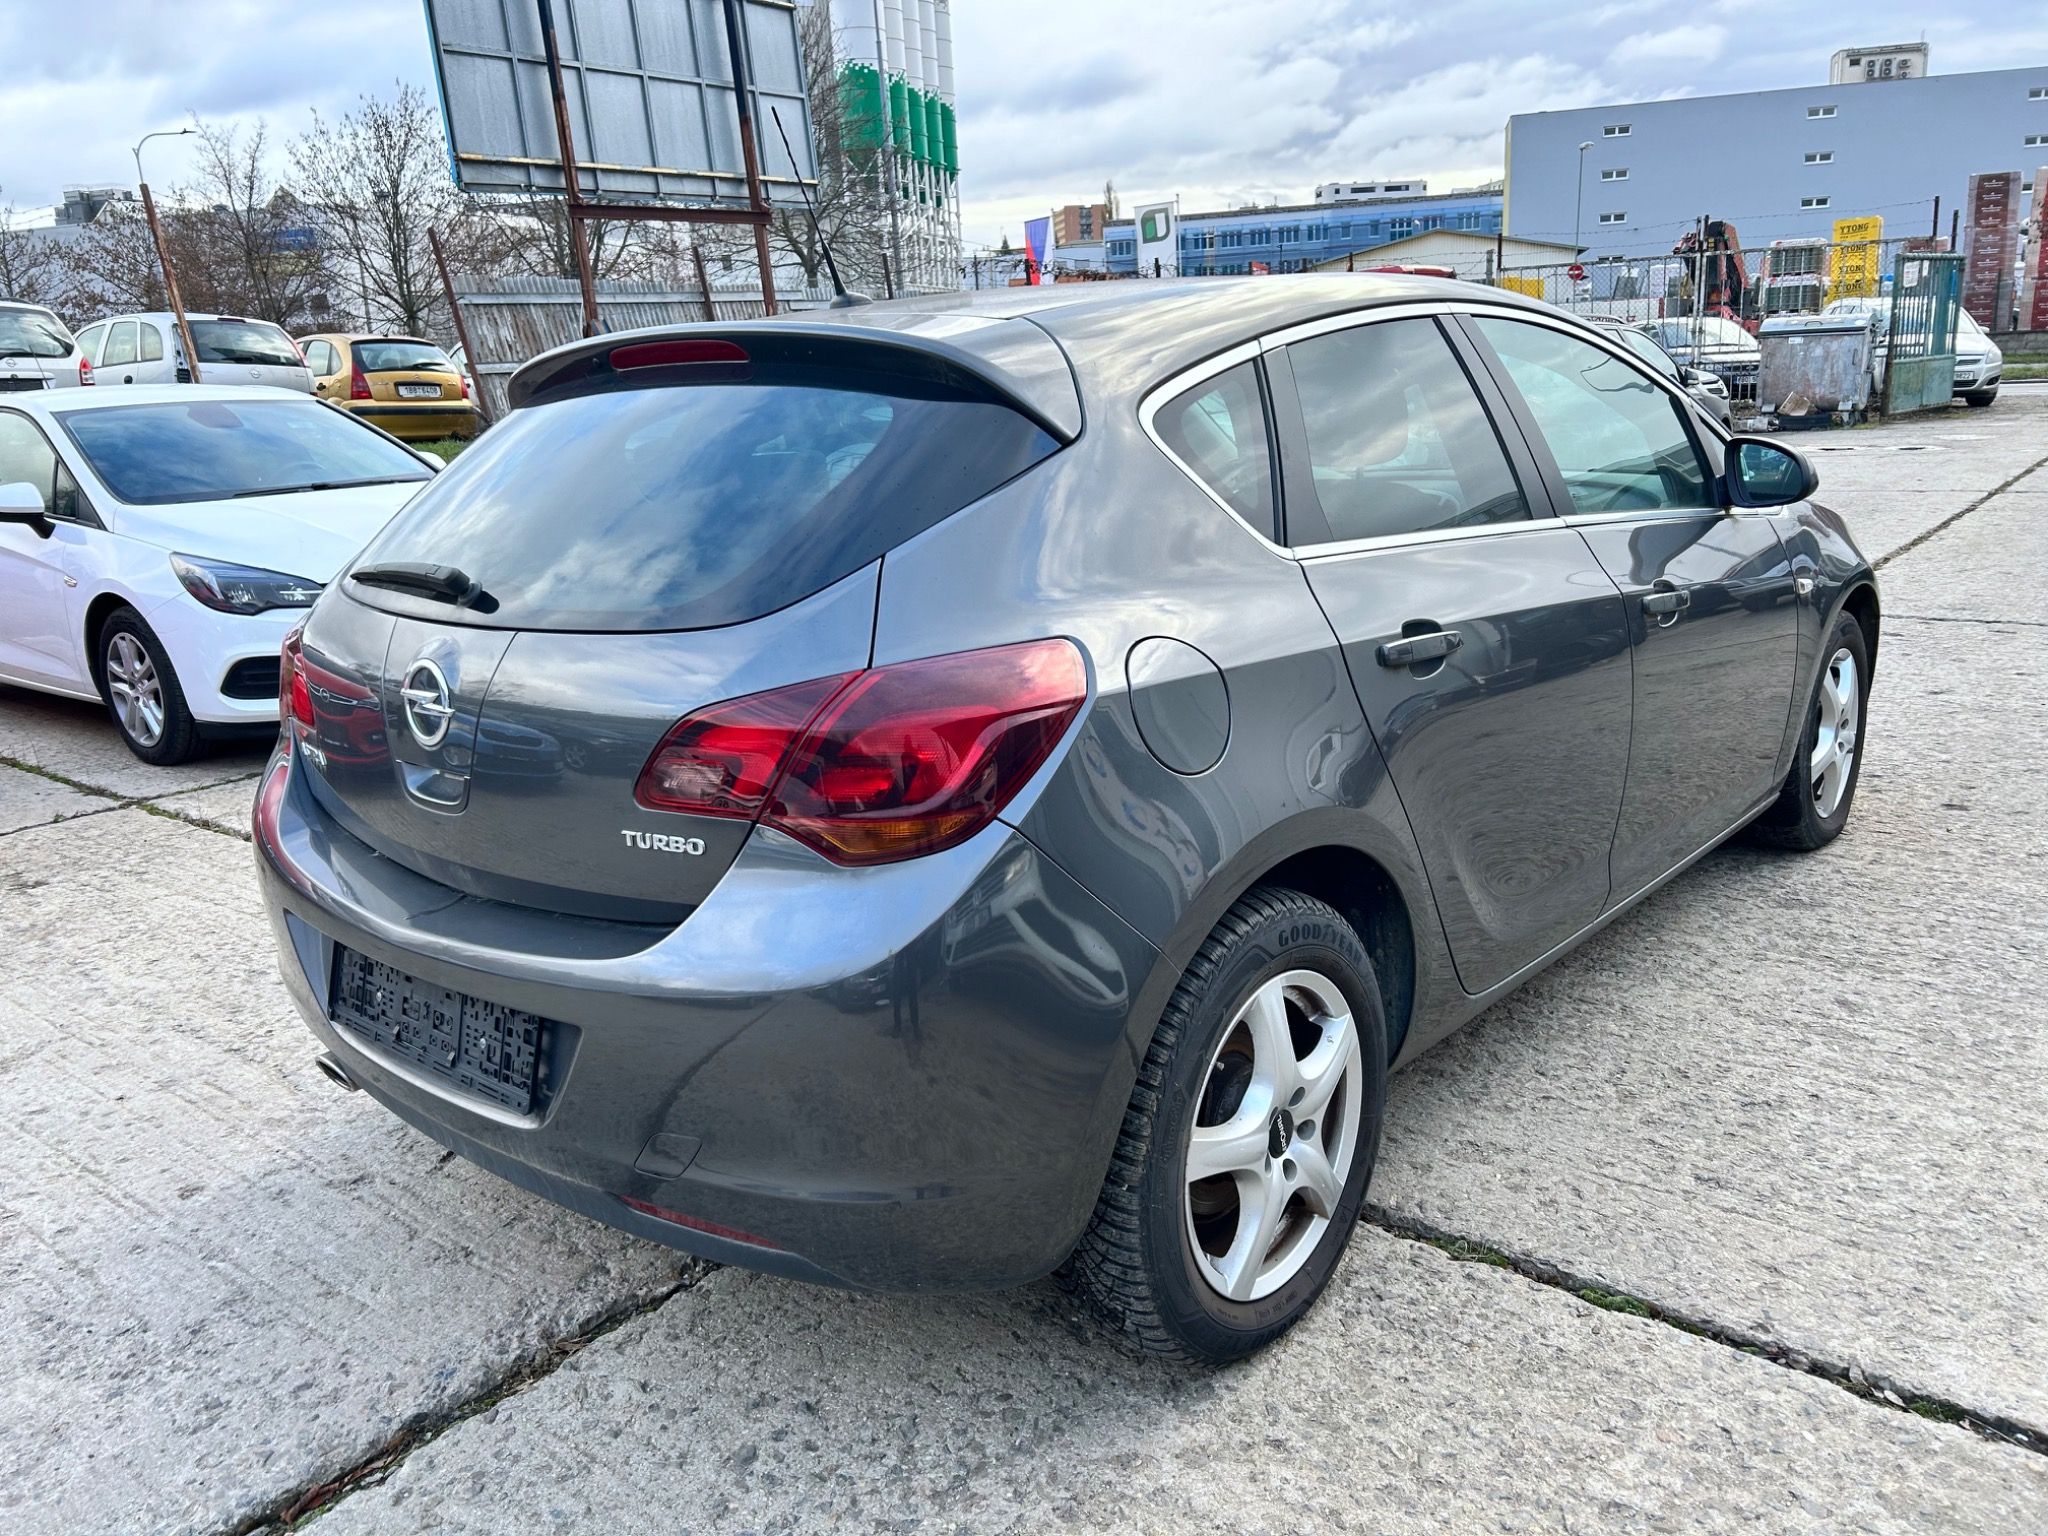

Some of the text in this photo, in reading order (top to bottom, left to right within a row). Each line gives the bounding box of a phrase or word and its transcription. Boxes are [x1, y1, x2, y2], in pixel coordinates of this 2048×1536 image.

[1840, 222, 1869, 233] YTONG
[621, 829, 706, 856] TURBO
[1277, 1114, 1287, 1148] RONAL
